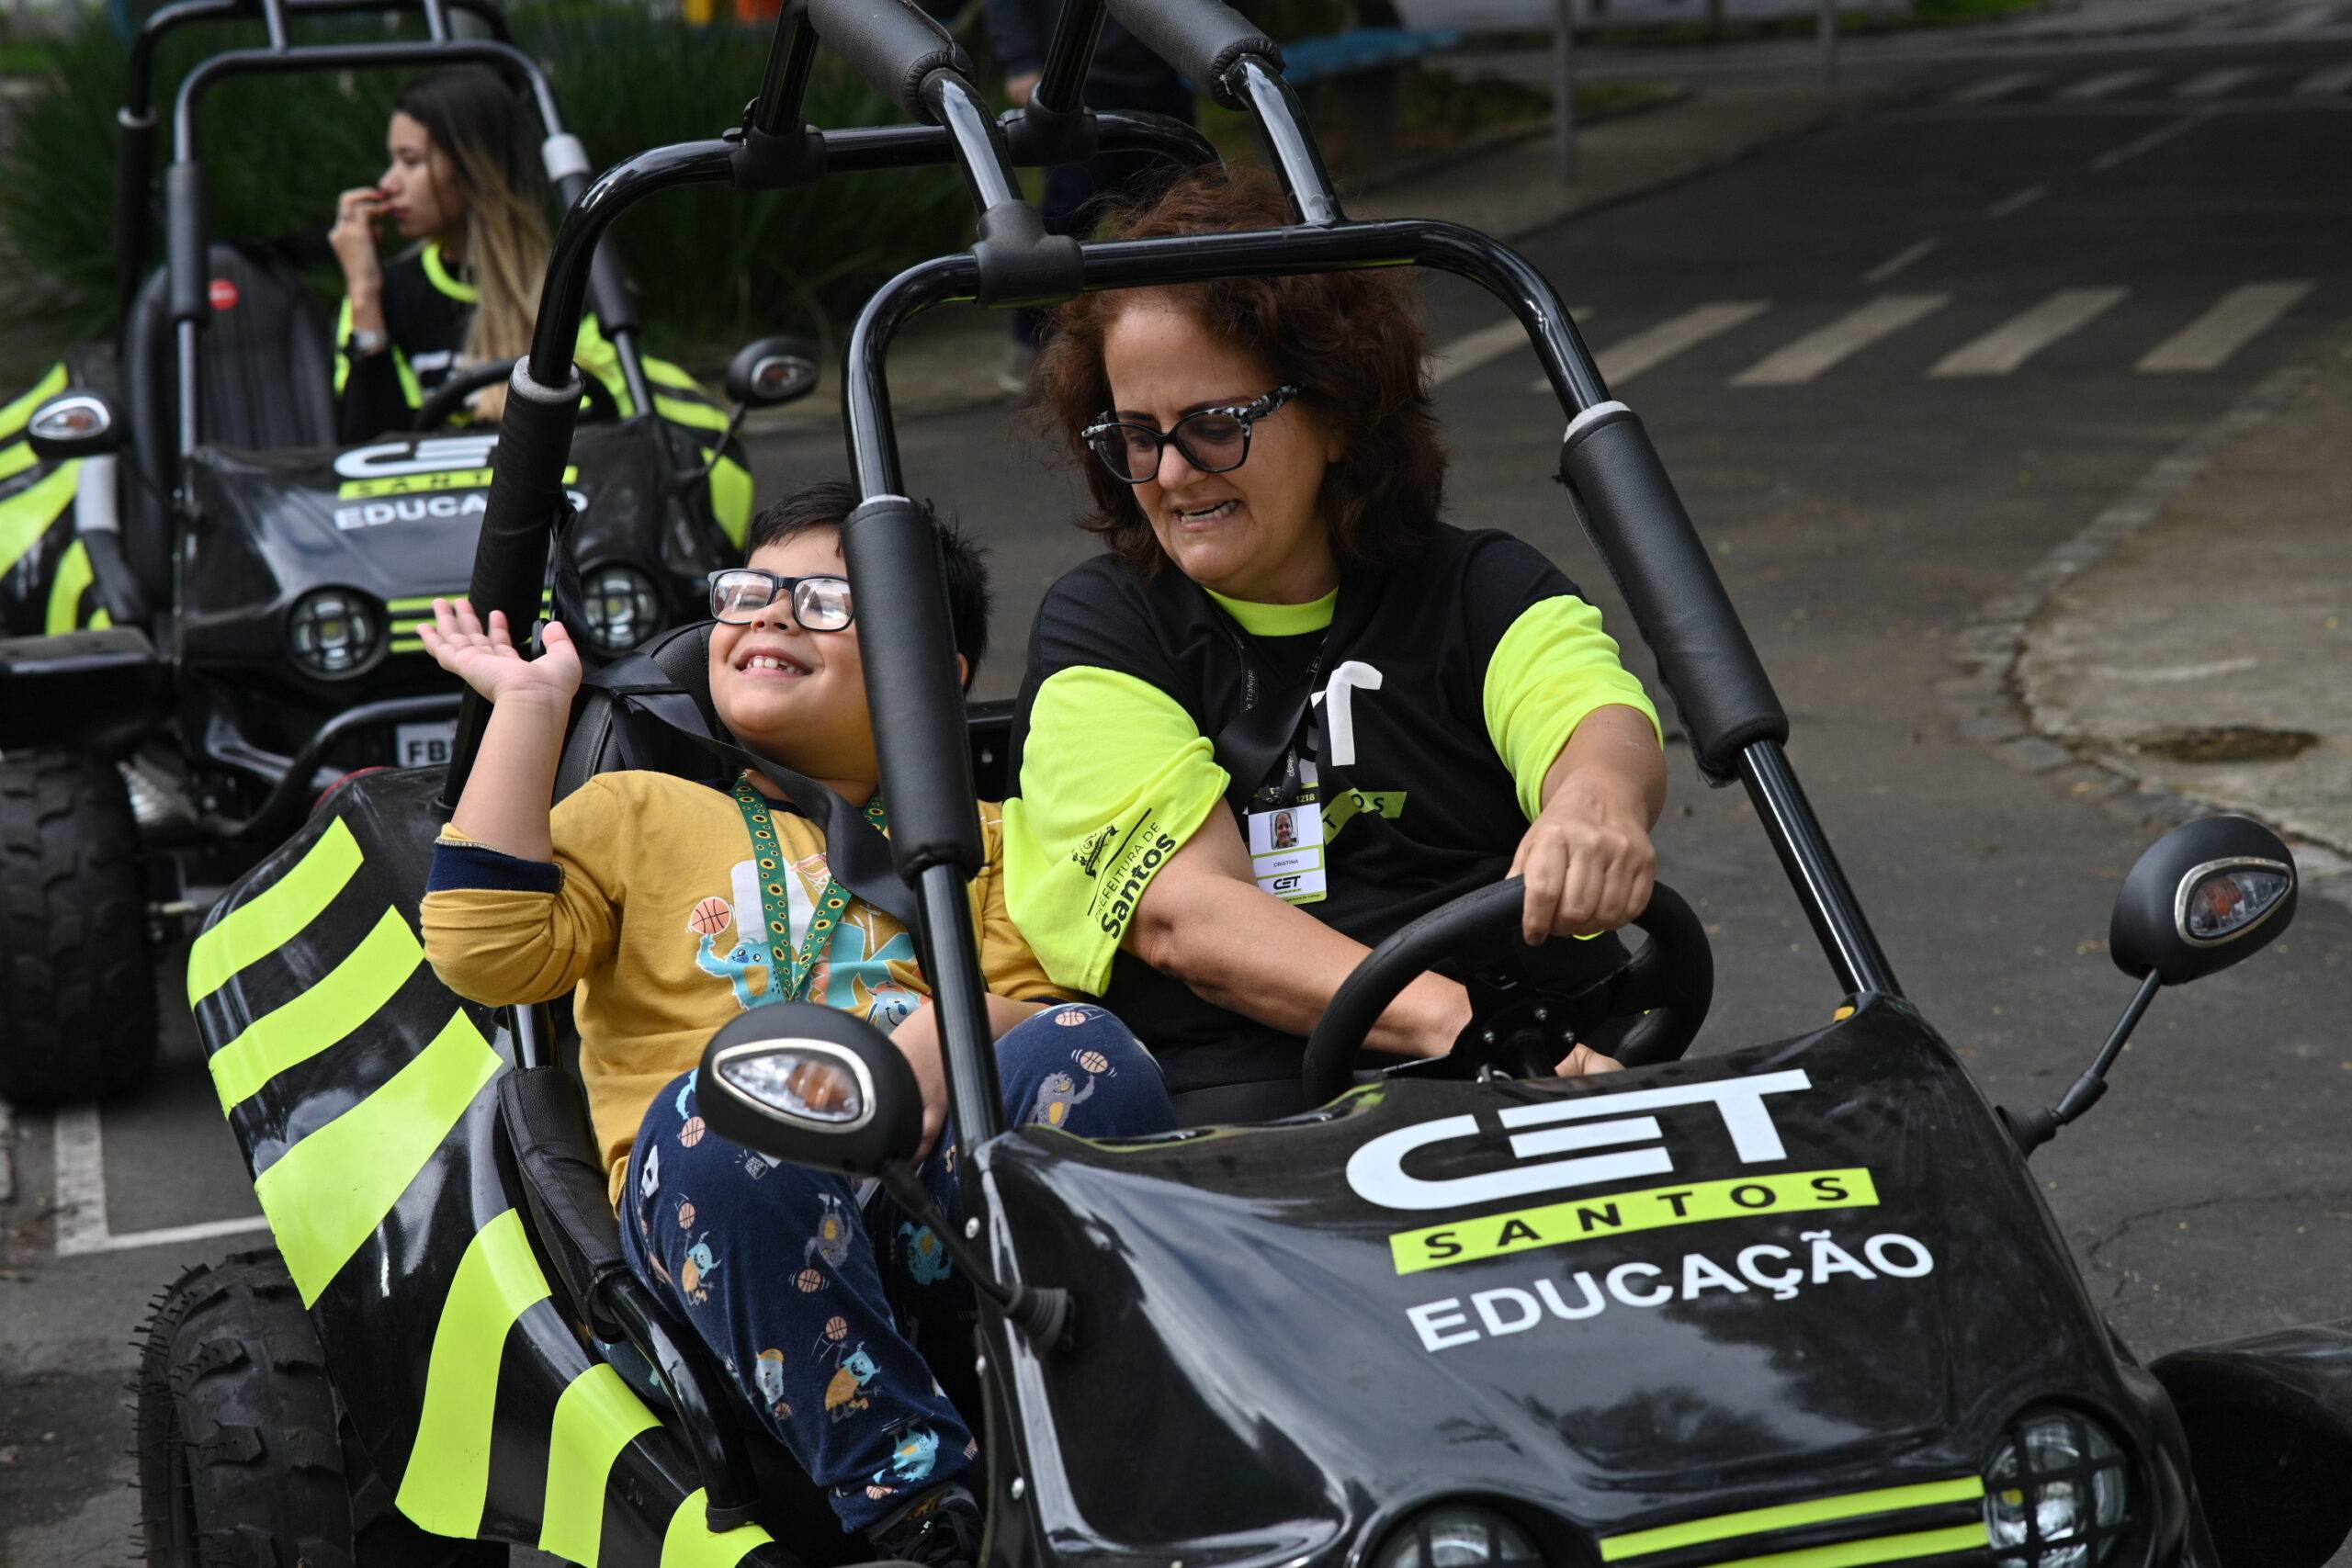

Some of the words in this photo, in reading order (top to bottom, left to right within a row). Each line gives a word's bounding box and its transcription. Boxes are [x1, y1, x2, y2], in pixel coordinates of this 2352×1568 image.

[334, 434, 500, 478] CE
[356, 470, 486, 495] SANT
[1295, 794, 1316, 804] 1218
[1142, 822, 1160, 842] DE
[1273, 859, 1299, 868] CRISTINA
[1102, 833, 1177, 940] Santos
[1273, 875, 1301, 890] CET
[1346, 1069, 1812, 1211] CET
[1425, 1177, 1849, 1259] SANTOS
[1406, 1229, 1935, 1352] EDUCAÇÃO
